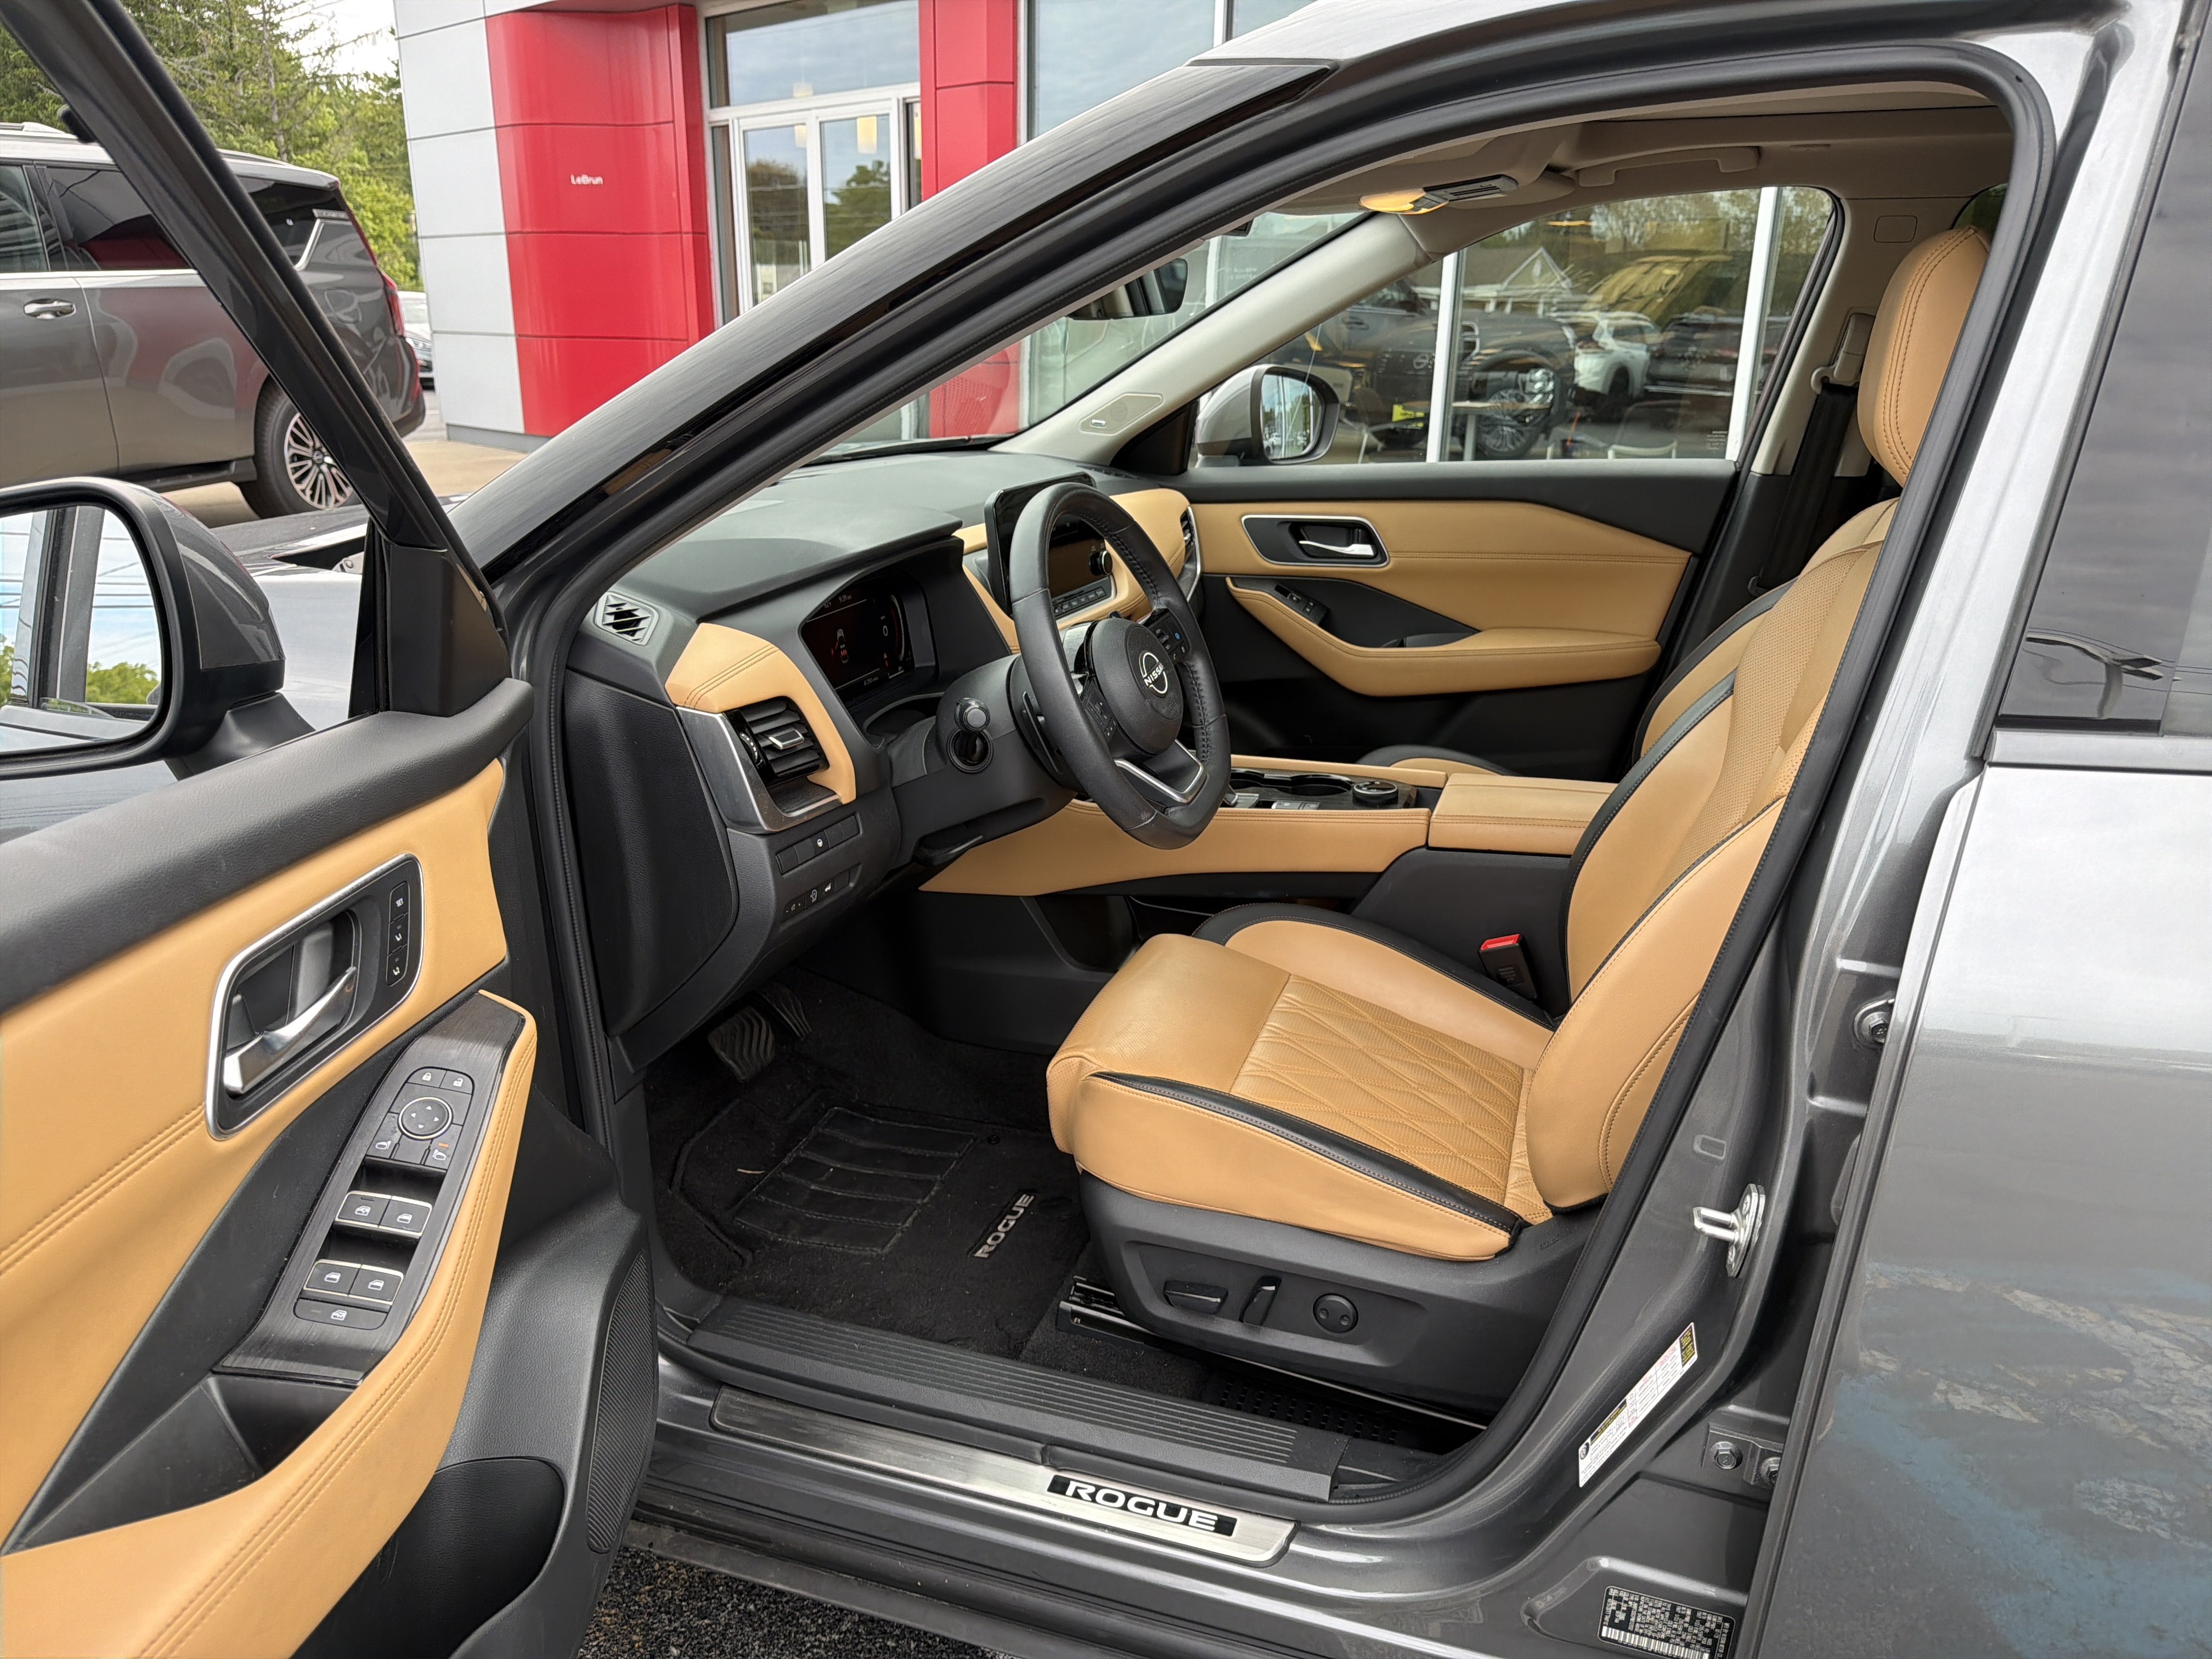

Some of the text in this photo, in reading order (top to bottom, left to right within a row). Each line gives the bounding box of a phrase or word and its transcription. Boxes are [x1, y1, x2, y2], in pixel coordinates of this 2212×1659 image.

[571, 174, 603, 185] LeBrun
[974, 1194, 1035, 1258] ROGUE
[1065, 1480, 1218, 1532] ROGUE
